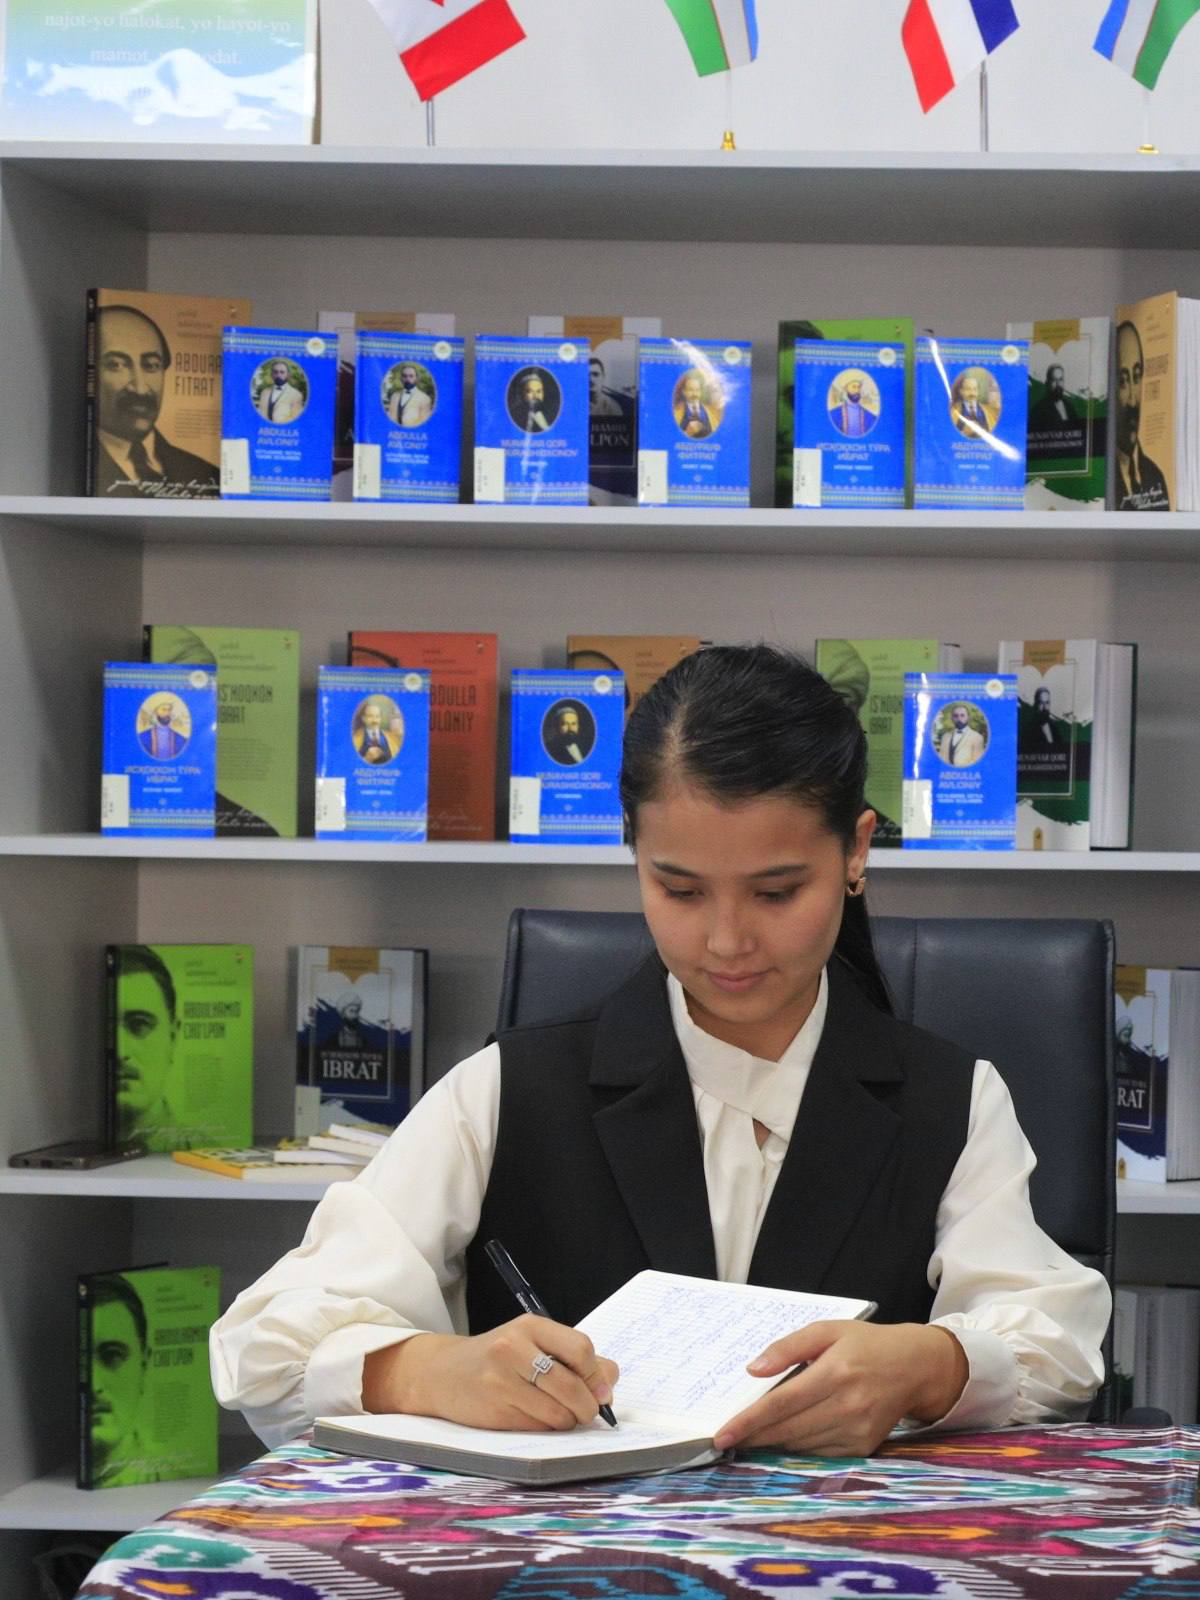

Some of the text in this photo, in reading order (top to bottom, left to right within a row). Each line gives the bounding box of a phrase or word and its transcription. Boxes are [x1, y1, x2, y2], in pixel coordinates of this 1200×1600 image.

[175, 376, 214, 398] FITRAT
[429, 684, 477, 706] BDULLA
[428, 710, 474, 732] VLONIY
[322, 1058, 383, 1080] IBRAT
[1117, 1086, 1146, 1109] RAT
